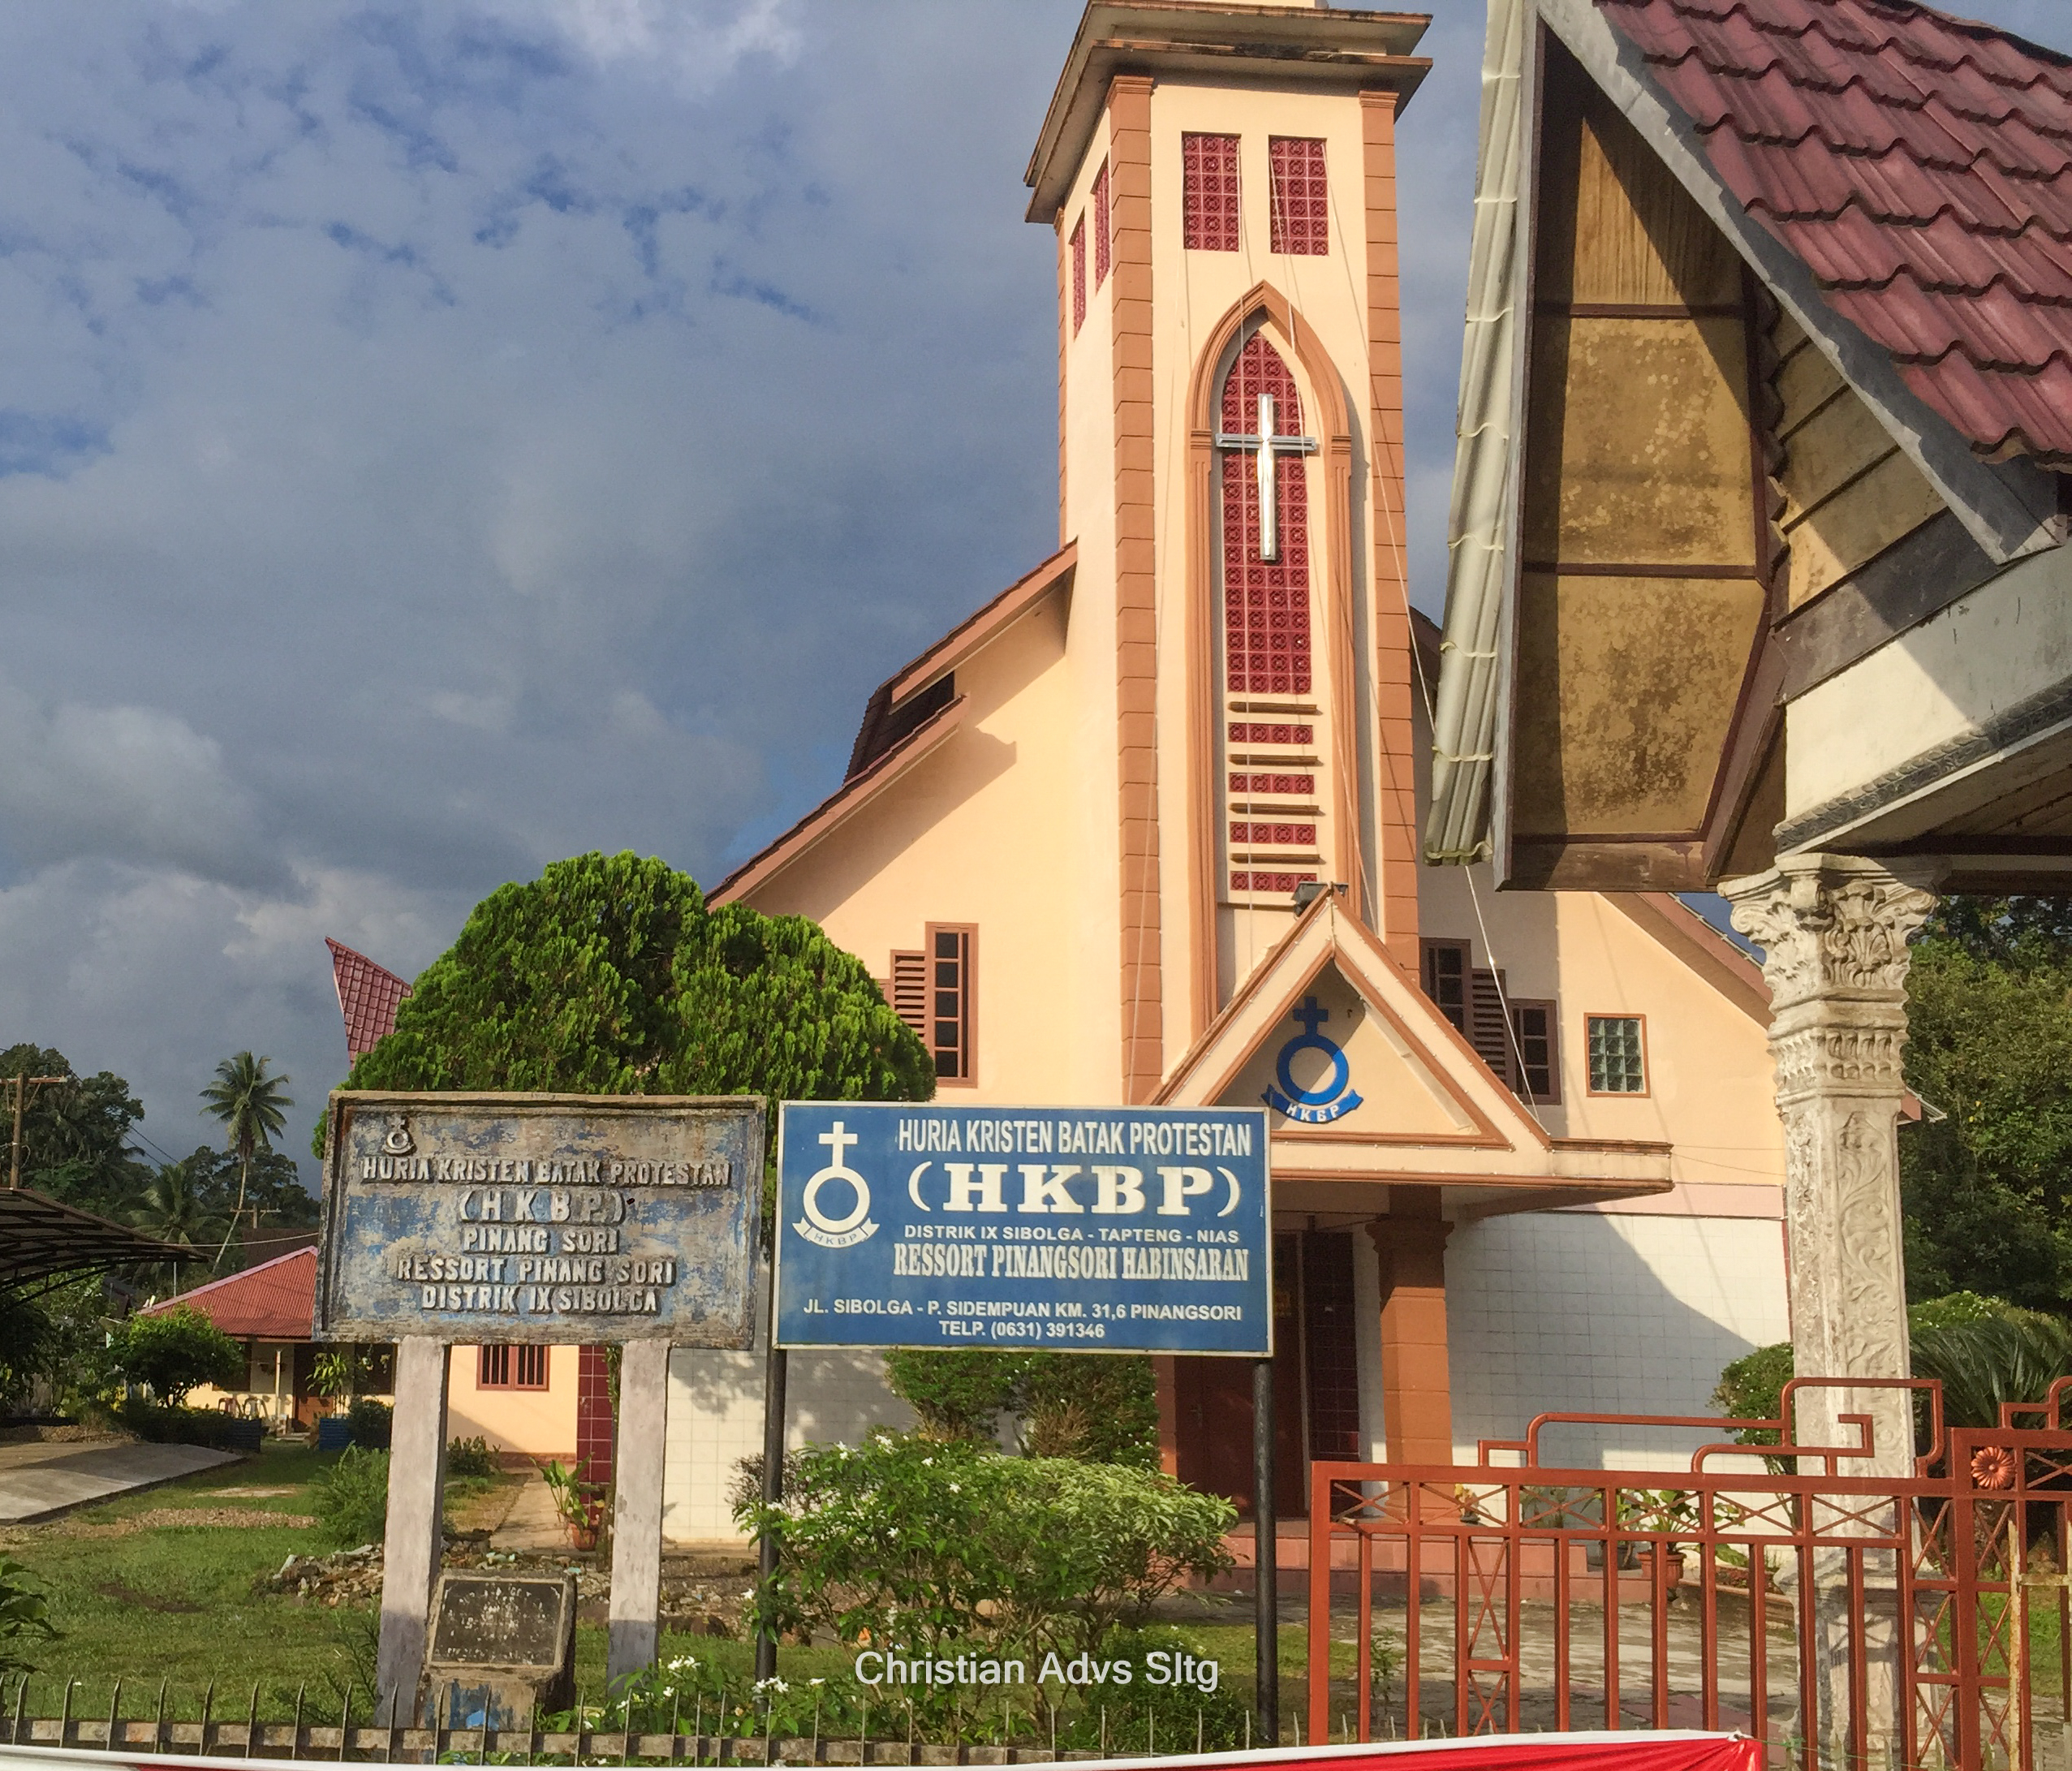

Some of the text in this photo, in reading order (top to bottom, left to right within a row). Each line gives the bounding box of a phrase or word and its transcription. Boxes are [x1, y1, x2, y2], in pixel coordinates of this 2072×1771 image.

[1286, 1104, 1339, 1122] HKBP
[898, 1119, 1251, 1156] HURIA KRISTEN BATAK PROTESTAN
[363, 1157, 730, 1186] HURIA KRISTEN BATAK PROTESTAN
[908, 1161, 1241, 1217] (HKBP)
[464, 1228, 618, 1254] PINANG SORI
[814, 1233, 857, 1245] HKBP
[905, 1226, 976, 1239] DISTRIK
[980, 1226, 998, 1239] IX
[1002, 1226, 1082, 1241] SIBOLGA
[1099, 1228, 1181, 1243] TAPTENG
[1197, 1230, 1238, 1243] NIAS
[398, 1256, 675, 1286] RESSORT PINANG SORI
[894, 1243, 1249, 1281] RESSORT PINANGSORI HABINSARAN
[422, 1285, 657, 1315] DISTRIK IX SIBOLGA
[803, 1300, 829, 1314] JL.
[834, 1301, 912, 1316] SIBOLGA
[928, 1302, 941, 1316] P.
[947, 1302, 1051, 1318] SIDEMPUAN
[1056, 1303, 1087, 1318] KM.
[1092, 1304, 1126, 1321] 31,6
[1131, 1304, 1243, 1320] PINANGSORI
[939, 1321, 1105, 1339] TELP. (0631) 391346
